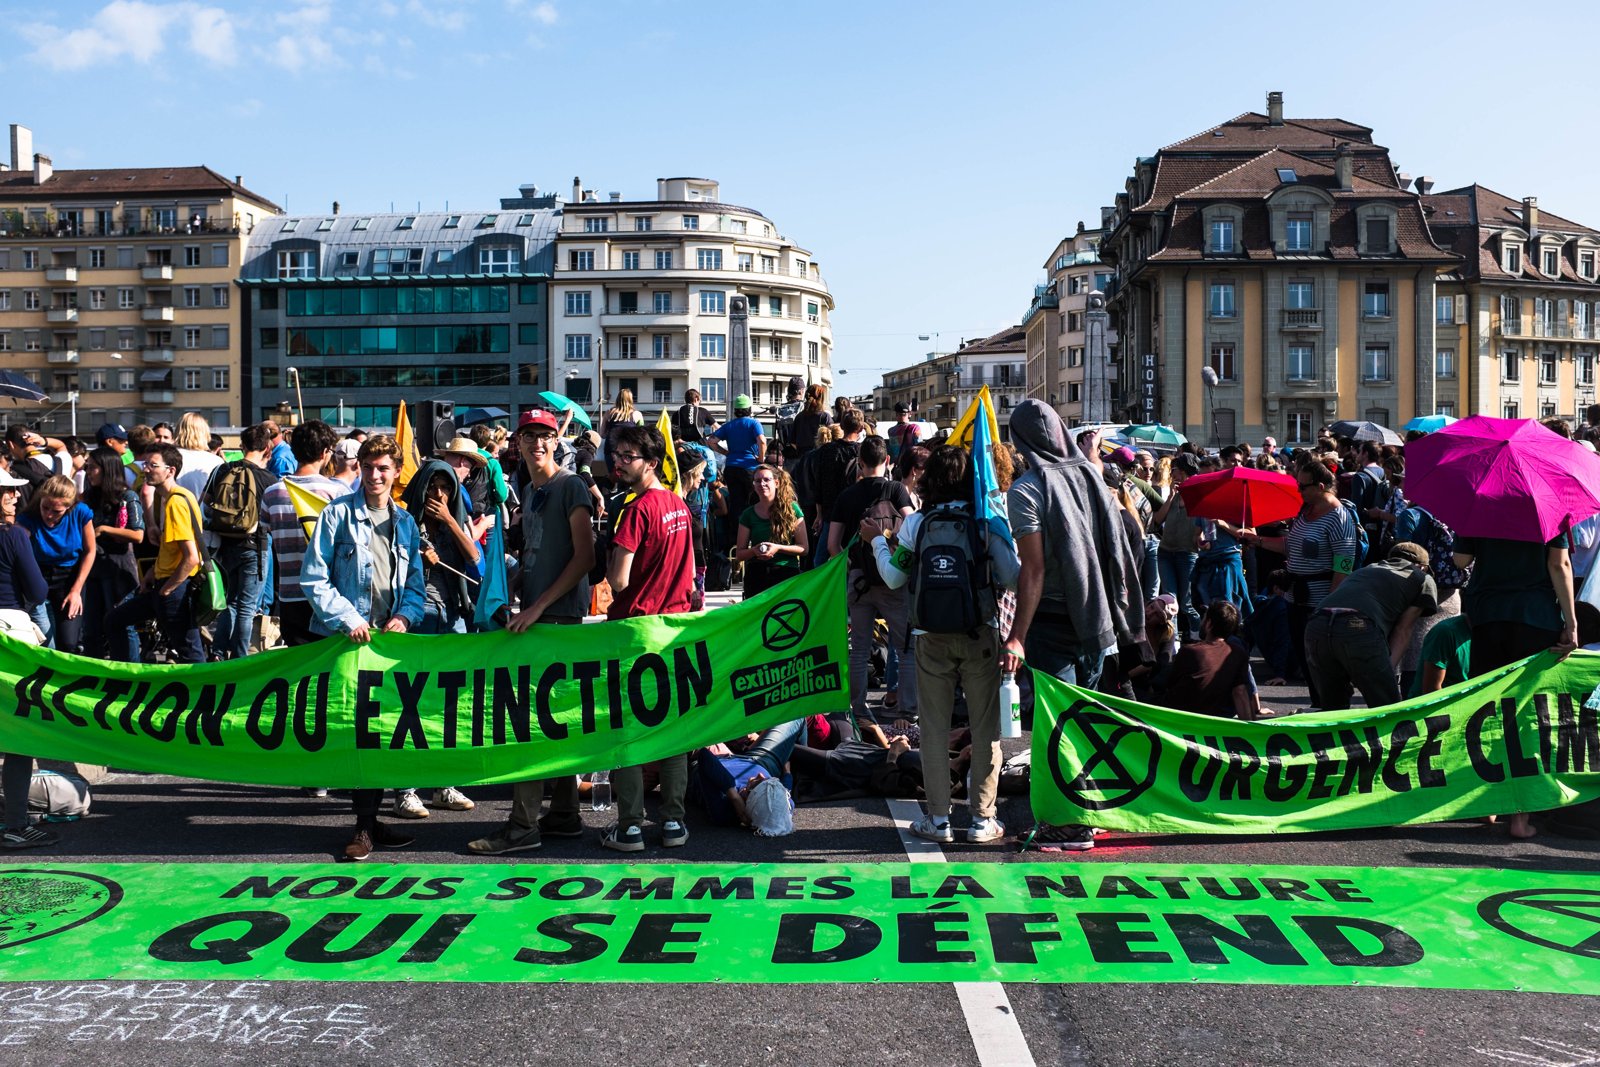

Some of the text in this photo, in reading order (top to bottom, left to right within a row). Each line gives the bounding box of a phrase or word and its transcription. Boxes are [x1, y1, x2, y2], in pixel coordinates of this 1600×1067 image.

[1145, 354, 1155, 424] HOTEL
[939, 558, 948, 569] B
[735, 654, 815, 692] extinction
[764, 671, 837, 707] rebellion
[14, 640, 713, 752] ACTION OU EXTINCTION
[1178, 692, 1600, 803] URGENCE CLIM
[219, 876, 1373, 902] NOUS SOMMES LA NATURE
[147, 901, 1424, 967] QUI SE DÉFEND
[0, 984, 270, 1001] OUPABLE
[67, 1023, 139, 1041] EN
